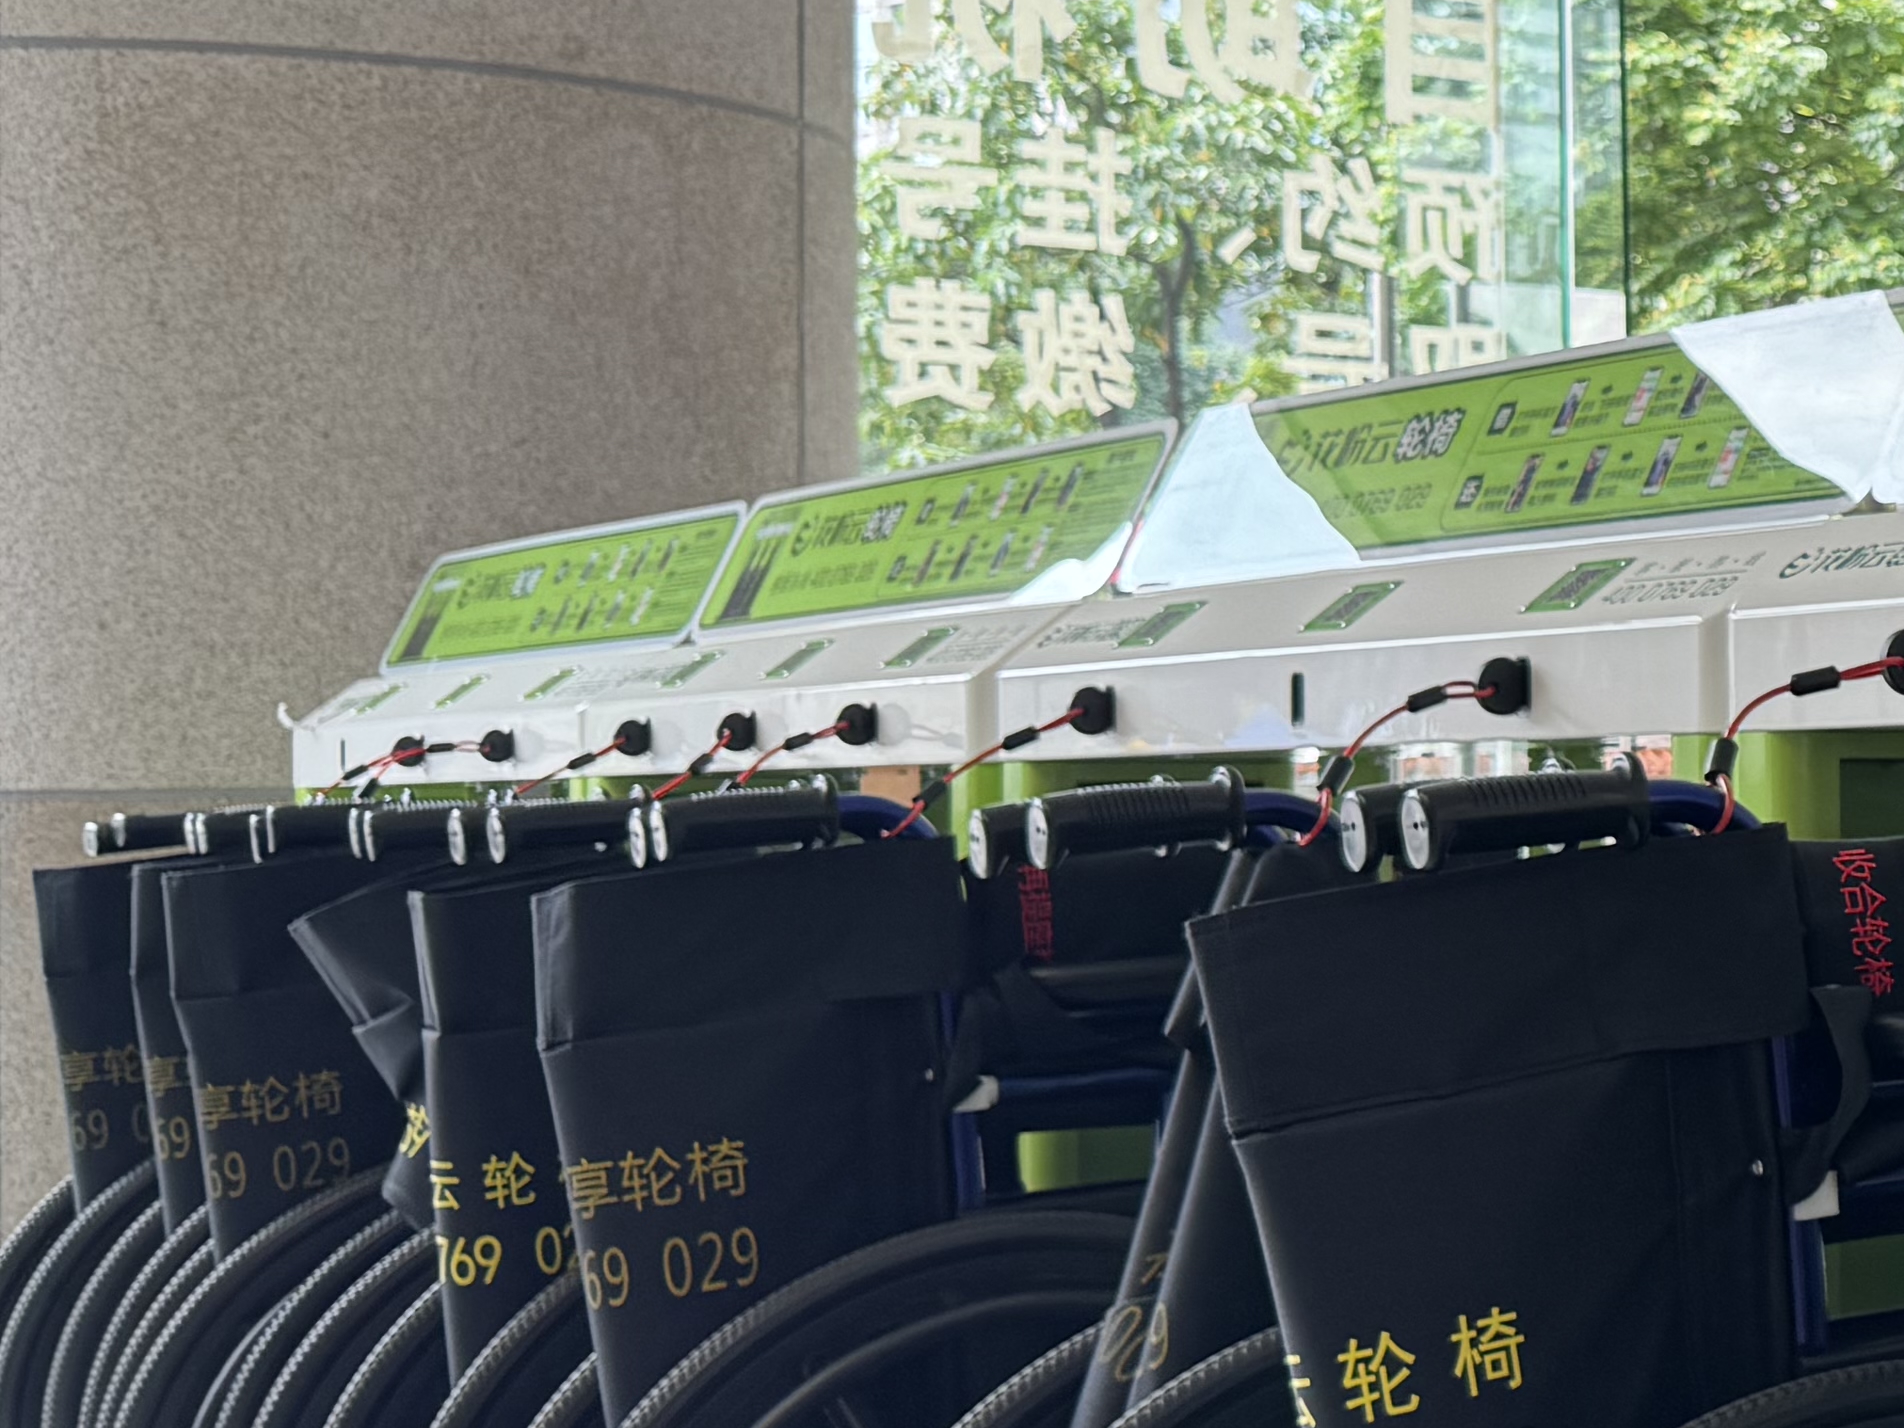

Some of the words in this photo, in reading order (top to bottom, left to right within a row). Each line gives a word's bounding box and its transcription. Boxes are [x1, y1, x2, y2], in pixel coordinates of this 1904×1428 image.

[1832, 848, 1895, 997] 收合轮椅
[662, 1225, 759, 1299] 029
